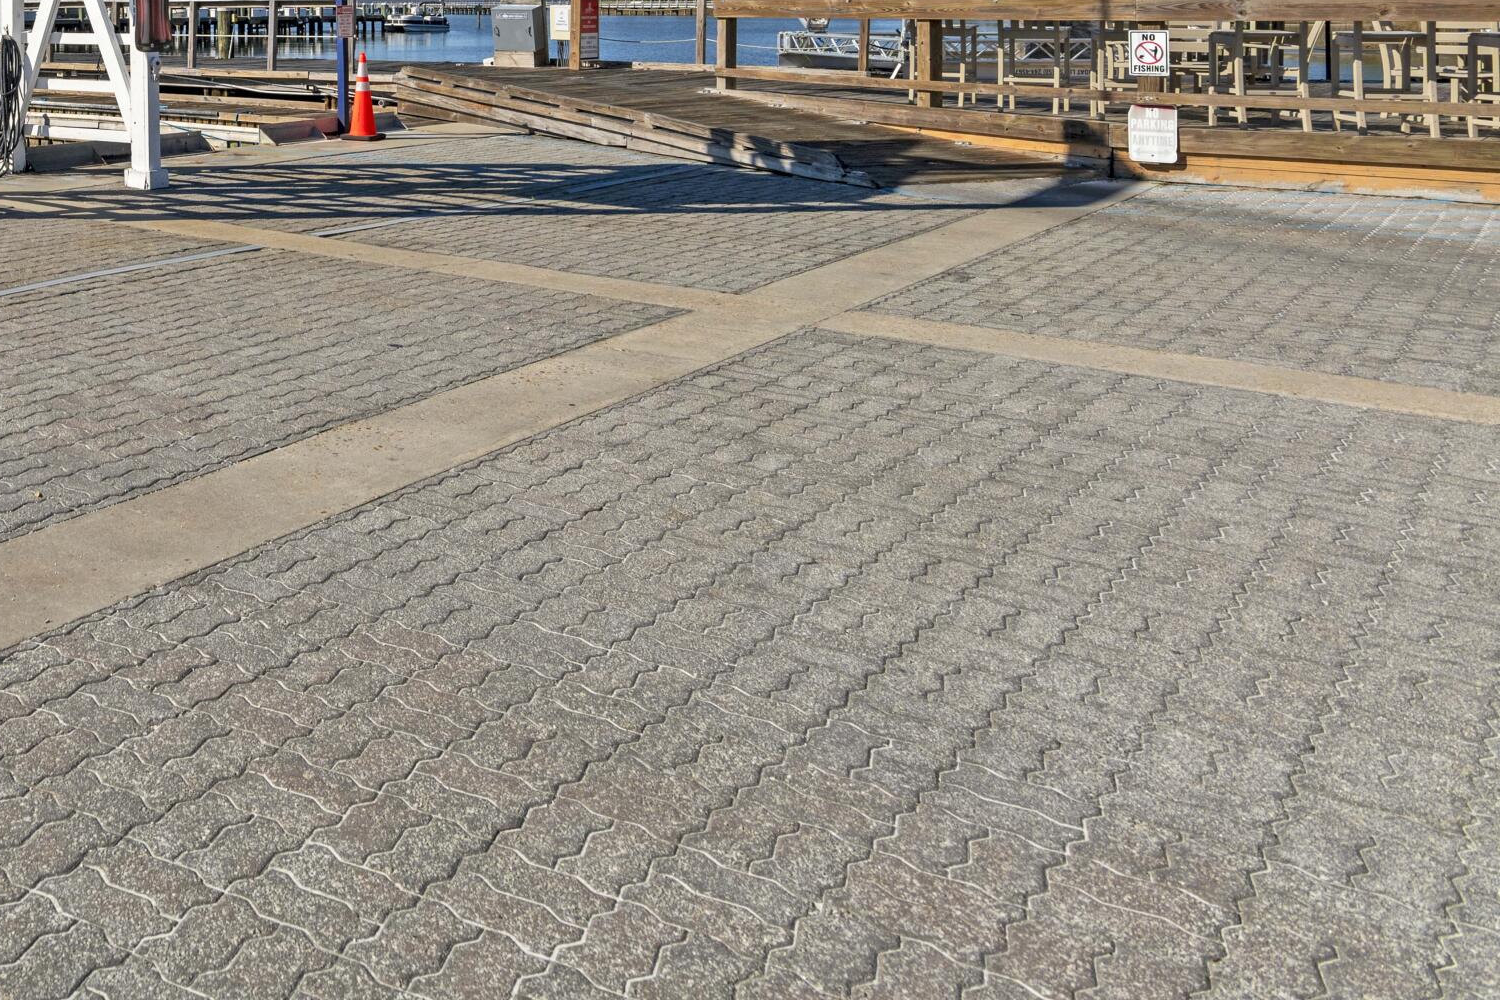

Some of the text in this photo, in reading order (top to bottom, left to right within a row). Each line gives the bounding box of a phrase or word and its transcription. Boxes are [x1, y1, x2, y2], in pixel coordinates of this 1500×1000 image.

[1141, 33, 1156, 41] NO
[1133, 64, 1165, 73] FISHING
[1144, 108, 1159, 119] NO
[1130, 118, 1175, 130] PARKING
[1131, 133, 1173, 146] ANYTIME
